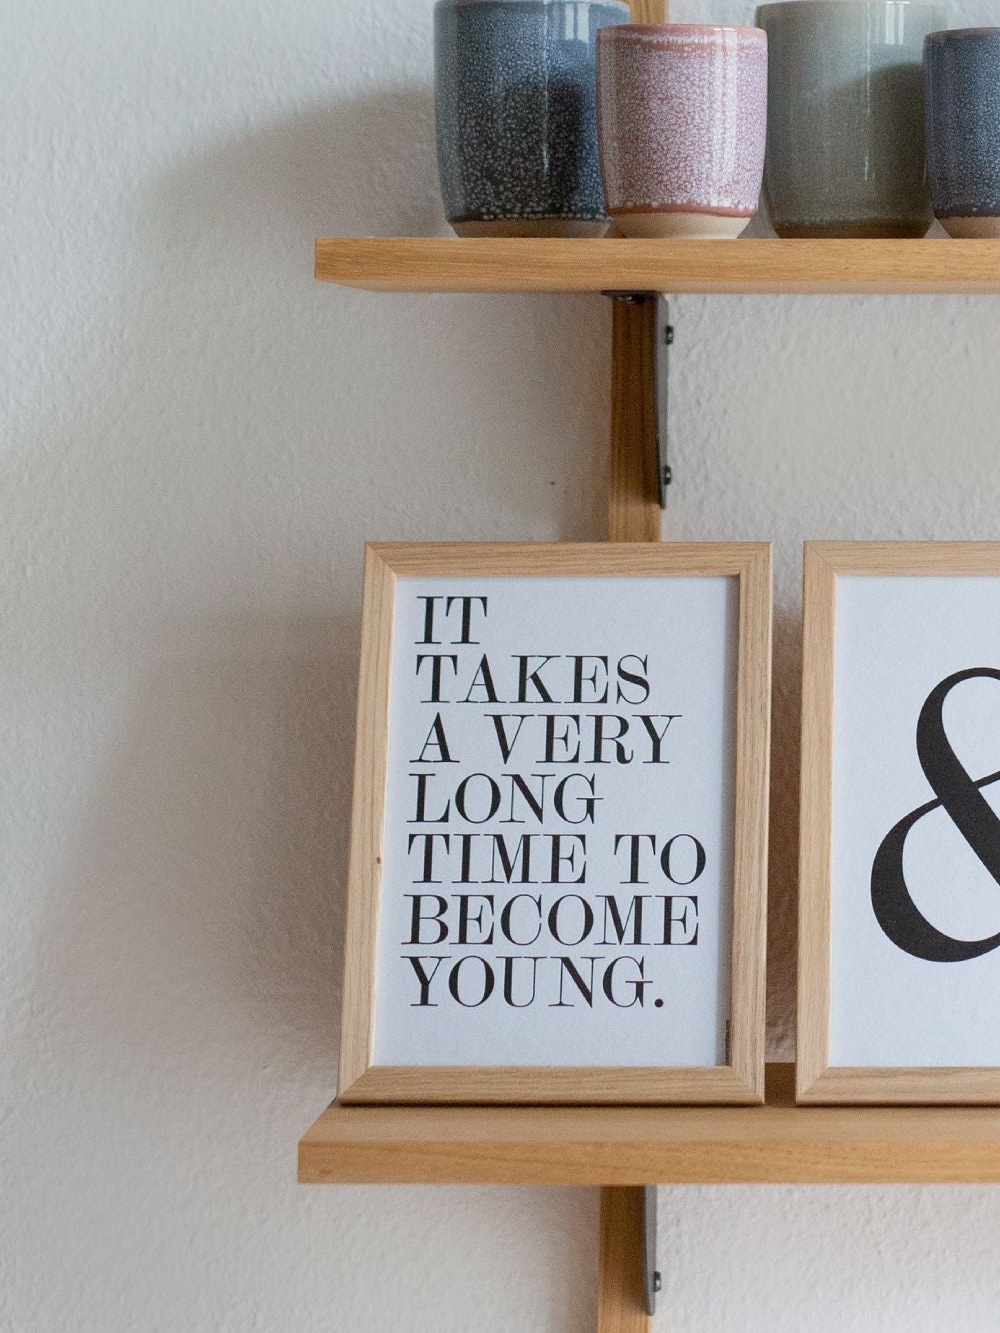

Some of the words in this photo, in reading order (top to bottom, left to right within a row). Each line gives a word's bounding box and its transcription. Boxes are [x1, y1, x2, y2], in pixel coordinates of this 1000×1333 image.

[414, 595, 488, 645] IT
[415, 653, 651, 705] TAKES
[409, 712, 461, 764] A
[483, 714, 683, 765] VERY
[406, 773, 604, 825] LONG
[407, 833, 588, 885] TIME
[614, 833, 707, 886] TO
[400, 893, 699, 947] BECOME
[400, 955, 666, 1009] YOUNG.
